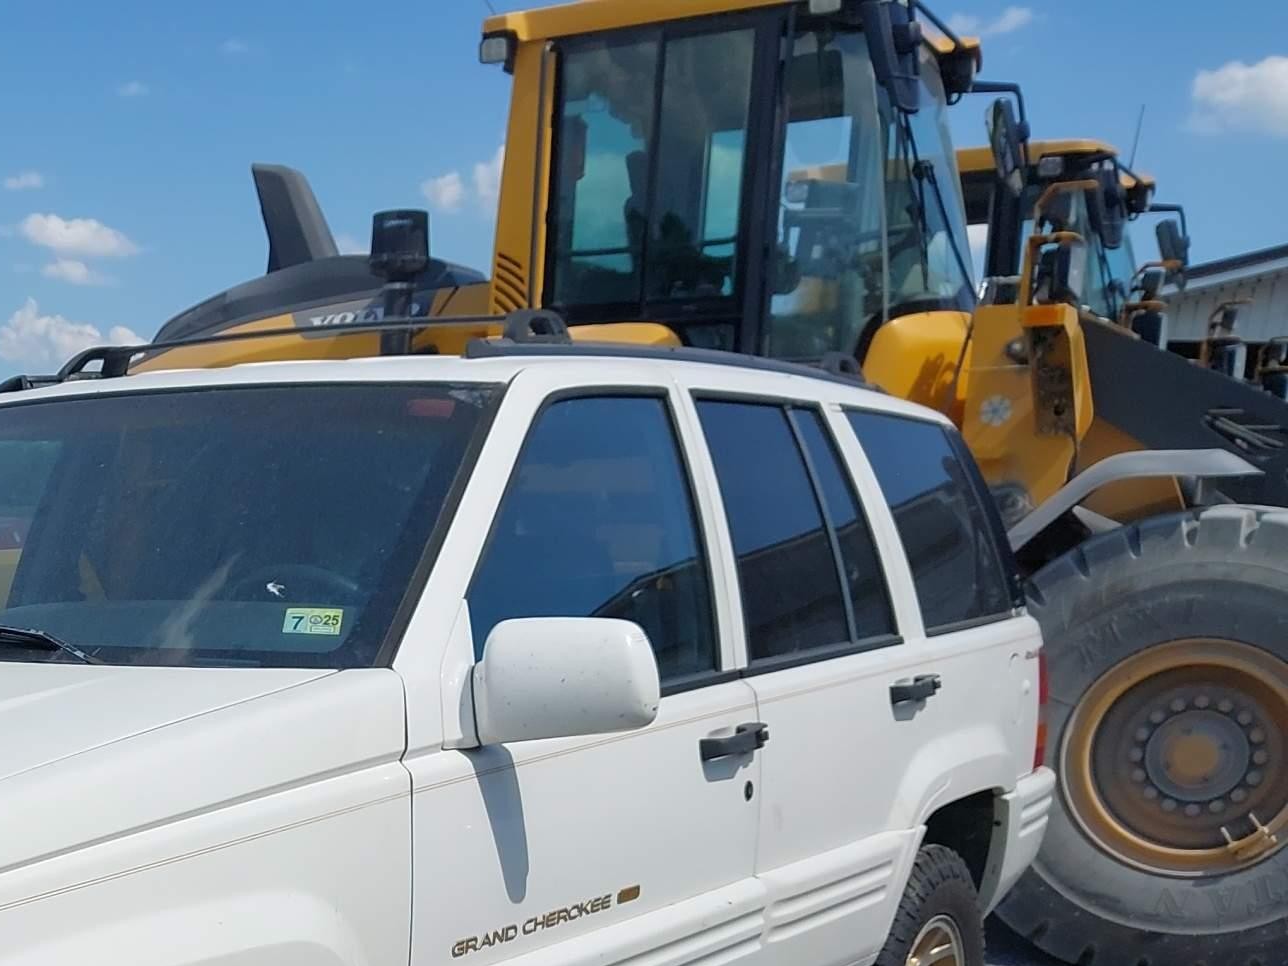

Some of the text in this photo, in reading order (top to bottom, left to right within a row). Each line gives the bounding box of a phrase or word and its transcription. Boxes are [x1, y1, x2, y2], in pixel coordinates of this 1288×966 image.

[291, 614, 340, 630] 7 25
[451, 893, 613, 959] GRAND CHEROKEE
